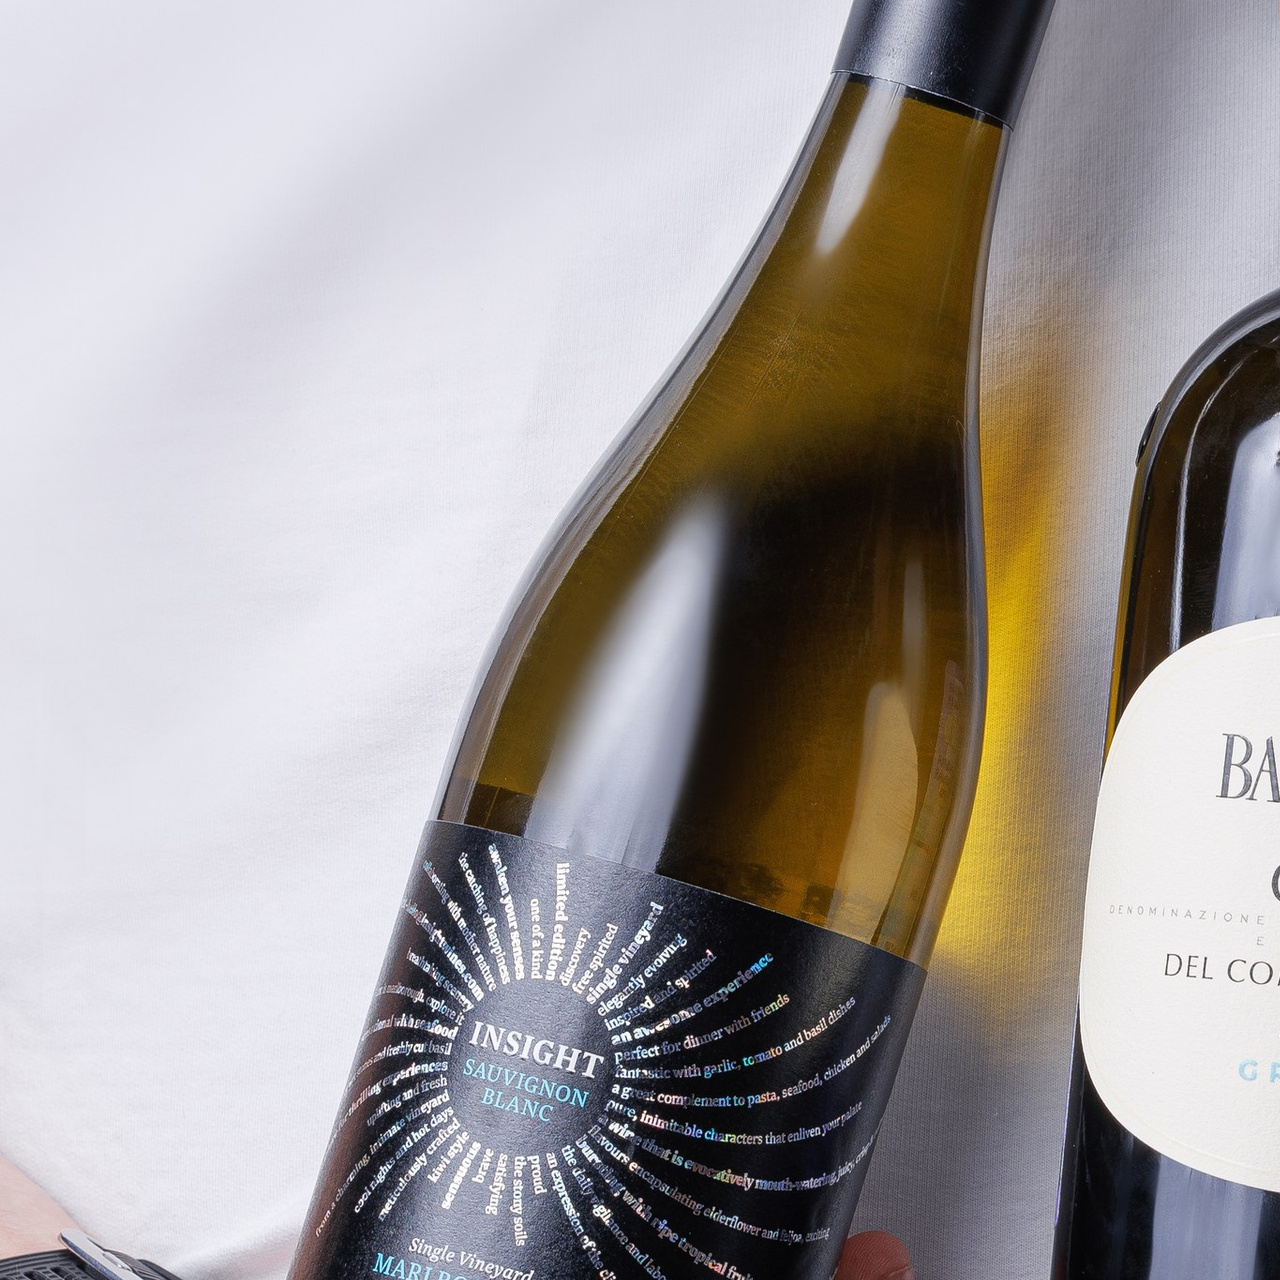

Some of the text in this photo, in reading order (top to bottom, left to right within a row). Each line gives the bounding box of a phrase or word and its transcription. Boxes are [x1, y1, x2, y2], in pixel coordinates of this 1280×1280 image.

[465, 869, 510, 985] catching of happiness
[488, 843, 524, 981] awaken your senses
[530, 898, 544, 980] one of a kind
[545, 862, 570, 981] limited edition
[1110, 904, 1265, 925] DENOMINAZIONE
[1256, 936, 1264, 946] E
[457, 918, 496, 992] mother nature
[559, 927, 592, 986] discovery
[572, 922, 618, 995] free spirited
[586, 901, 664, 1005] single vineyard
[597, 933, 688, 1016] elegantly evolving
[1164, 953, 1214, 980] DEL
[443, 980, 474, 1012] scenery
[456, 1012, 465, 1026] it
[604, 948, 716, 1031] inspired and spirited
[611, 952, 774, 1046] an awesome experience
[415, 1018, 458, 1040] seafood
[469, 1021, 604, 1078] INSIGHT
[614, 992, 790, 1064] perfect for dinner with friends
[674, 996, 856, 1078] with garlic, tomato and basil dishes
[382, 1060, 448, 1088] experiences
[402, 1074, 448, 1099] and fresh
[462, 1058, 590, 1108] SAUVIGNON
[620, 1014, 892, 1109] great complement to pasta, seafood, chicken and salads
[406, 1089, 450, 1123] vineyard
[426, 1117, 460, 1155] crafted
[482, 1088, 554, 1122] BLANC
[640, 1110, 840, 1144] inimitable characters that enliven your
[354, 1106, 454, 1214] cool nights and hot days
[428, 1130, 470, 1184] kiwi style
[442, 1140, 482, 1210] sensuous
[472, 1148, 494, 1183] brave
[485, 1153, 508, 1216] satisfying
[527, 1154, 547, 1195] proud
[587, 1124, 780, 1240] flavours encapsulating elderflower and
[641, 1139, 754, 1192] that is evocatively
[510, 1156, 528, 1246] the stony soils
[546, 1152, 558, 1168] an
[552, 1170, 584, 1236] expression
[562, 1144, 577, 1167] the
[572, 1166, 594, 1196] daily
[590, 1196, 628, 1246] vigilance
[626, 1243, 649, 1266] and
[408, 1237, 456, 1262] Single
[622, 1190, 652, 1222] with
[678, 1238, 729, 1275] tropical
